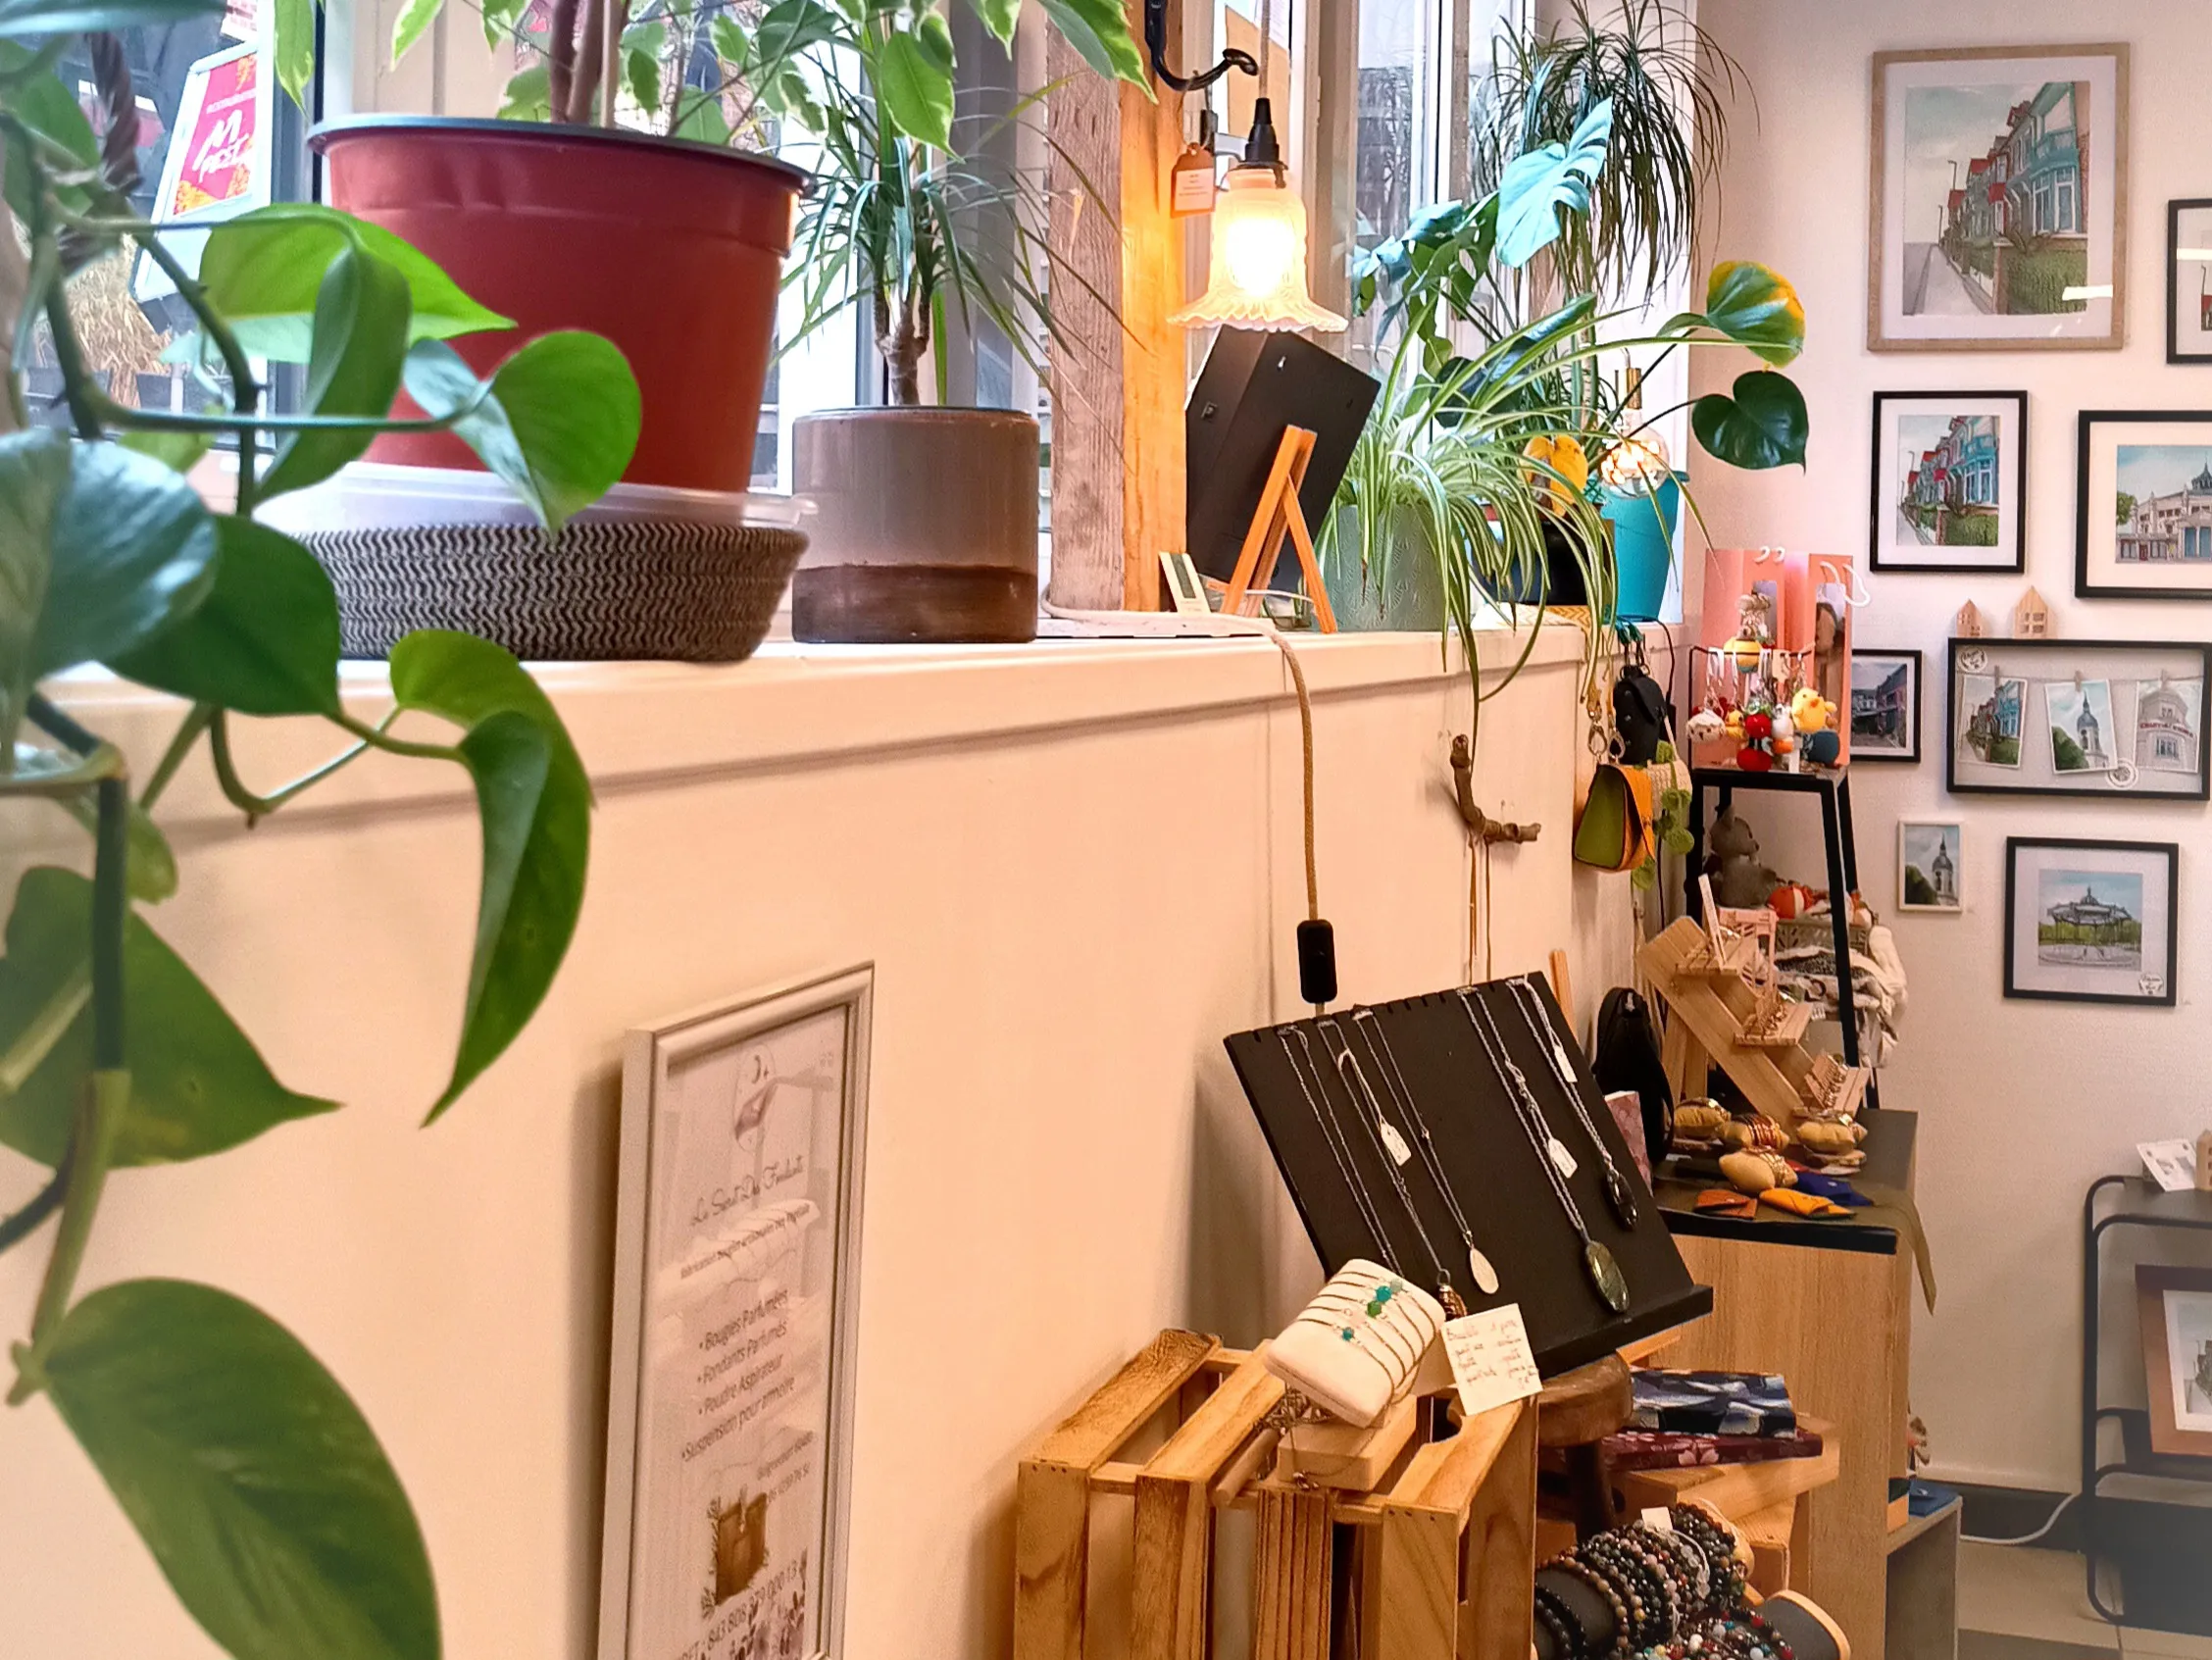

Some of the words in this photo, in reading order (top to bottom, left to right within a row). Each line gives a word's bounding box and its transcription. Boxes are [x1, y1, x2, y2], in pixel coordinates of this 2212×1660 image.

[704, 1347, 745, 1383] Fondants
[747, 1321, 787, 1357] Parfumés
[705, 1321, 741, 1351] Bougies
[704, 1384, 736, 1415] Poudre
[739, 1354, 783, 1390] Aspirateur
[739, 1399, 762, 1431] pour
[762, 1377, 794, 1409] armoire
